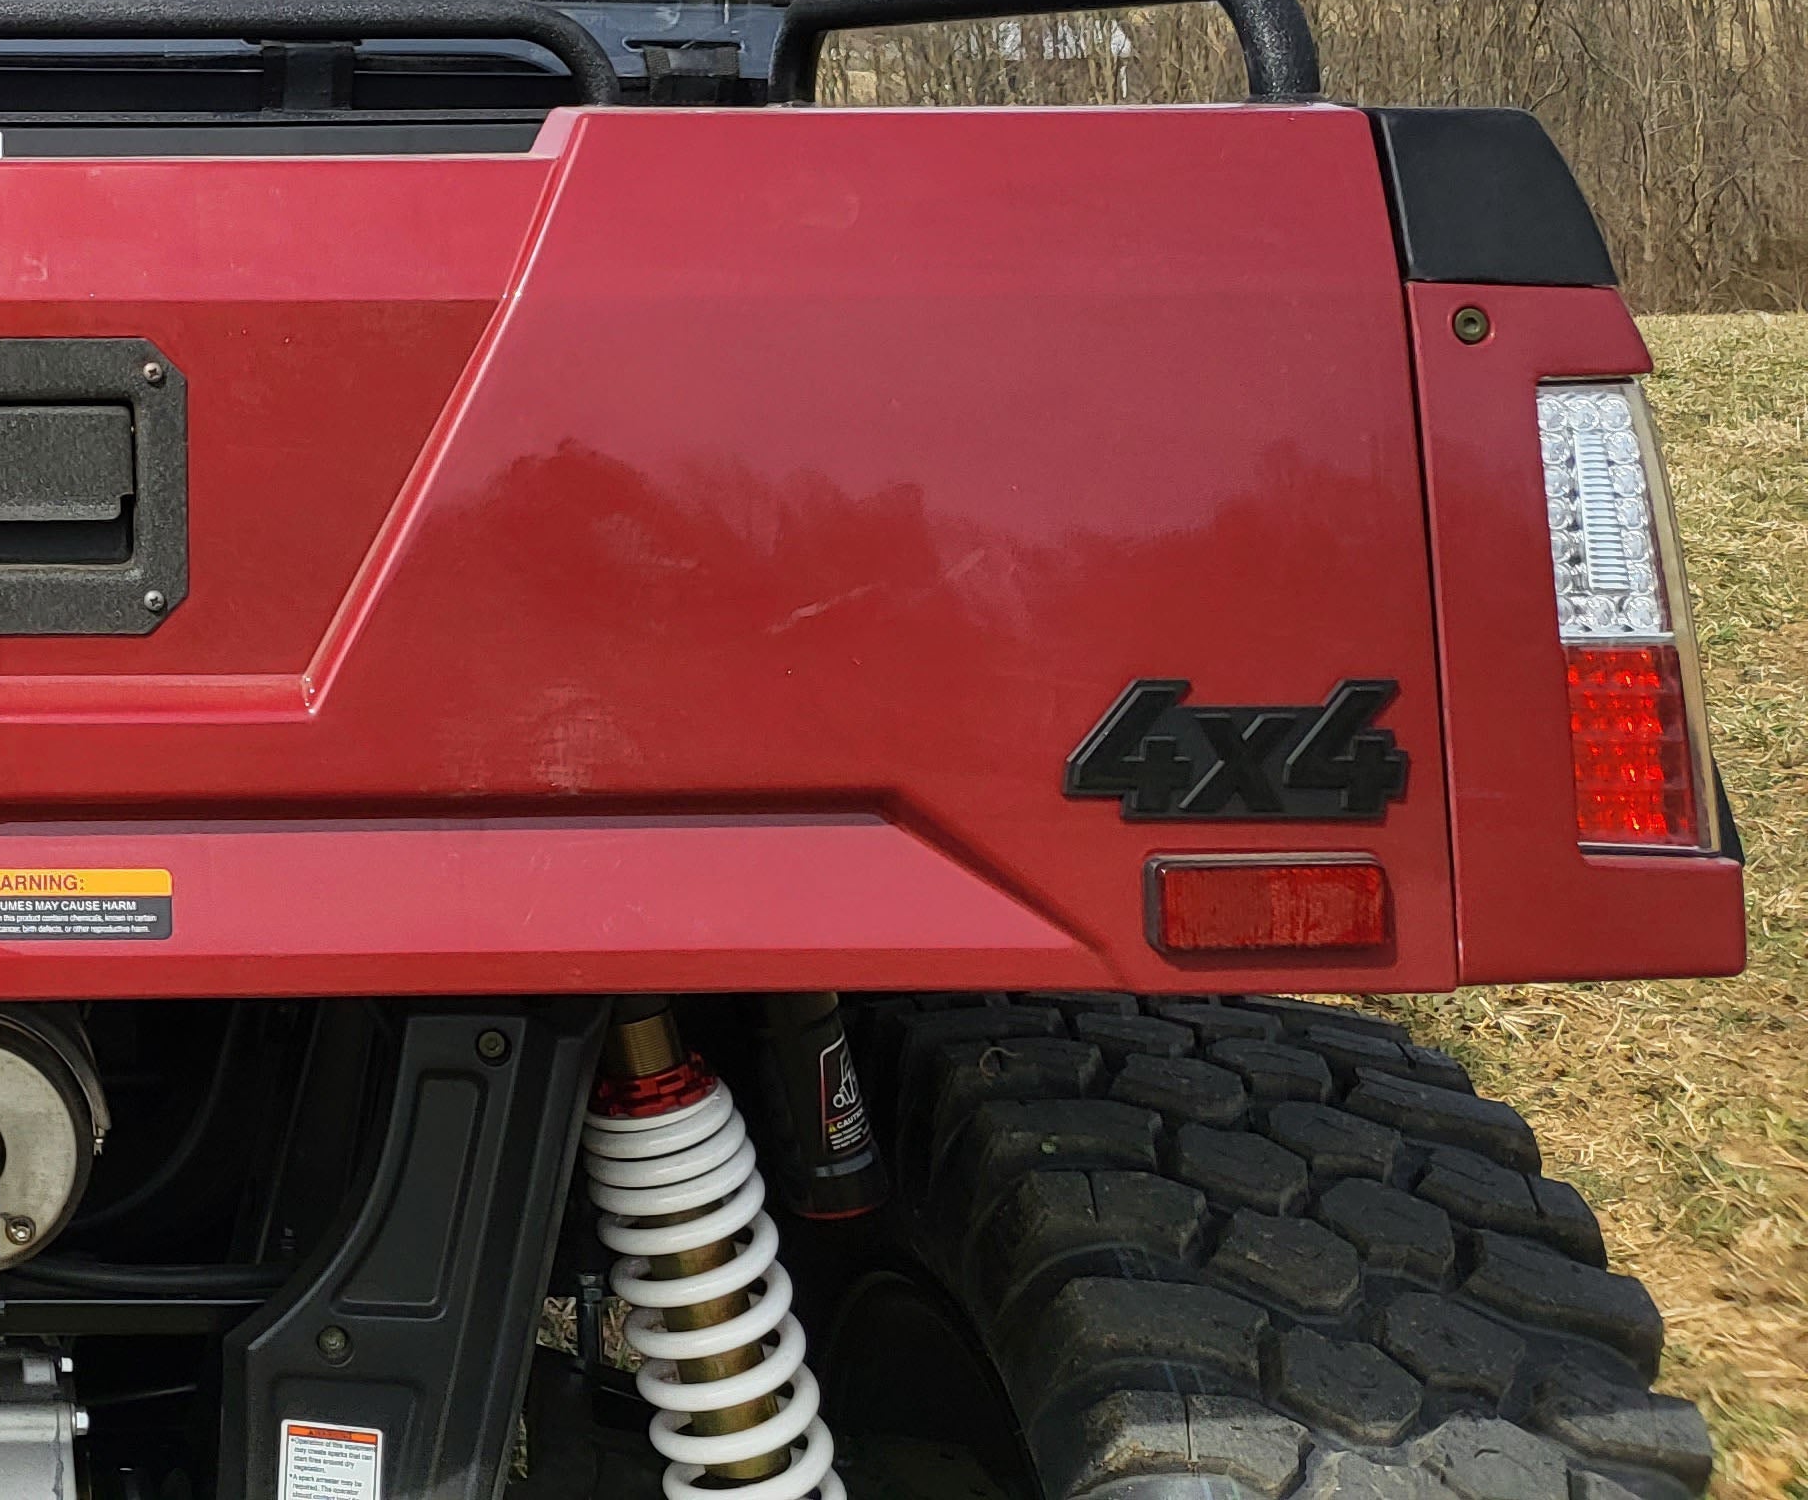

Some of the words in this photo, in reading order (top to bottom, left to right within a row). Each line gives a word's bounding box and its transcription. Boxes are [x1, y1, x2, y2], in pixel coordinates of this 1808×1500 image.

[35, 900, 59, 911] MAY
[61, 900, 101, 911] CAUSE
[102, 900, 137, 911] HARM
[4, 914, 15, 922] this
[17, 914, 41, 923] product
[836, 1107, 864, 1129] CAUTIO
